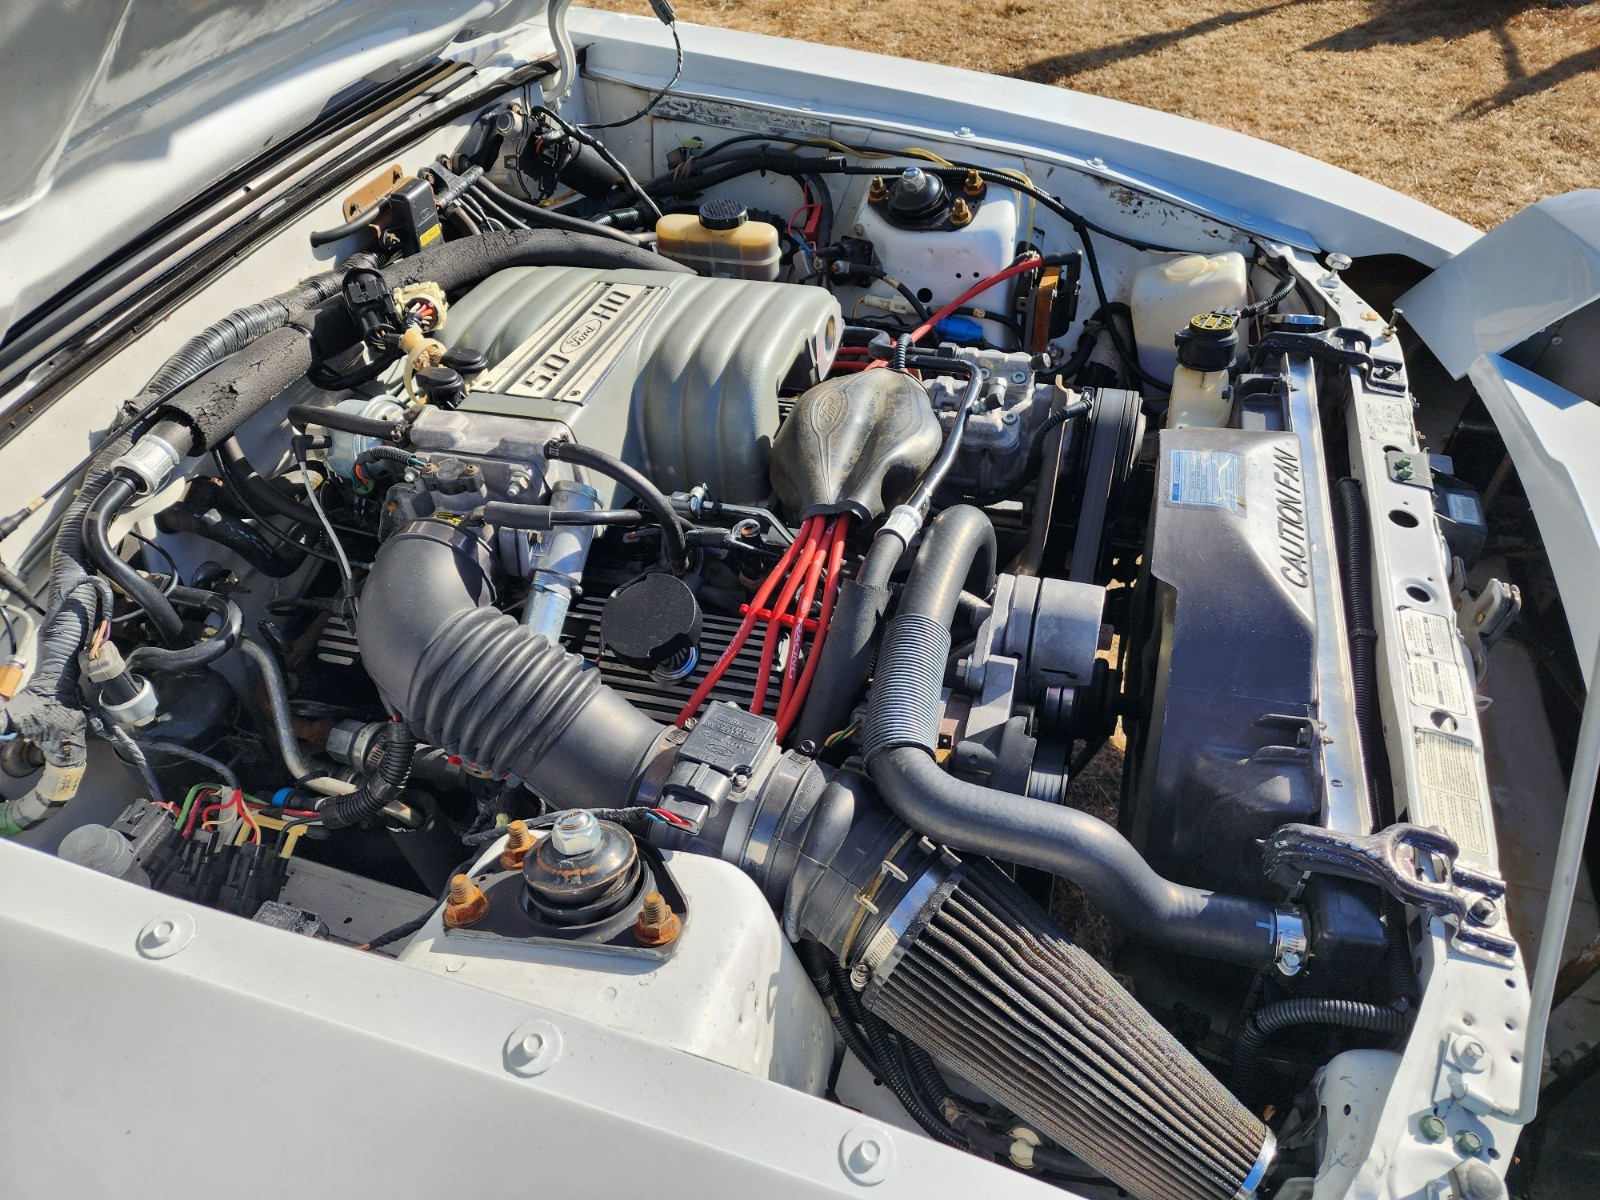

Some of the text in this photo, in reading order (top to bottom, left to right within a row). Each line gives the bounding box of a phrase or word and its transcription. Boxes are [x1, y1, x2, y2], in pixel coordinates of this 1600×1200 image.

[520, 353, 570, 392] 5.0
[1273, 446, 1310, 589] CAUTION FAN
